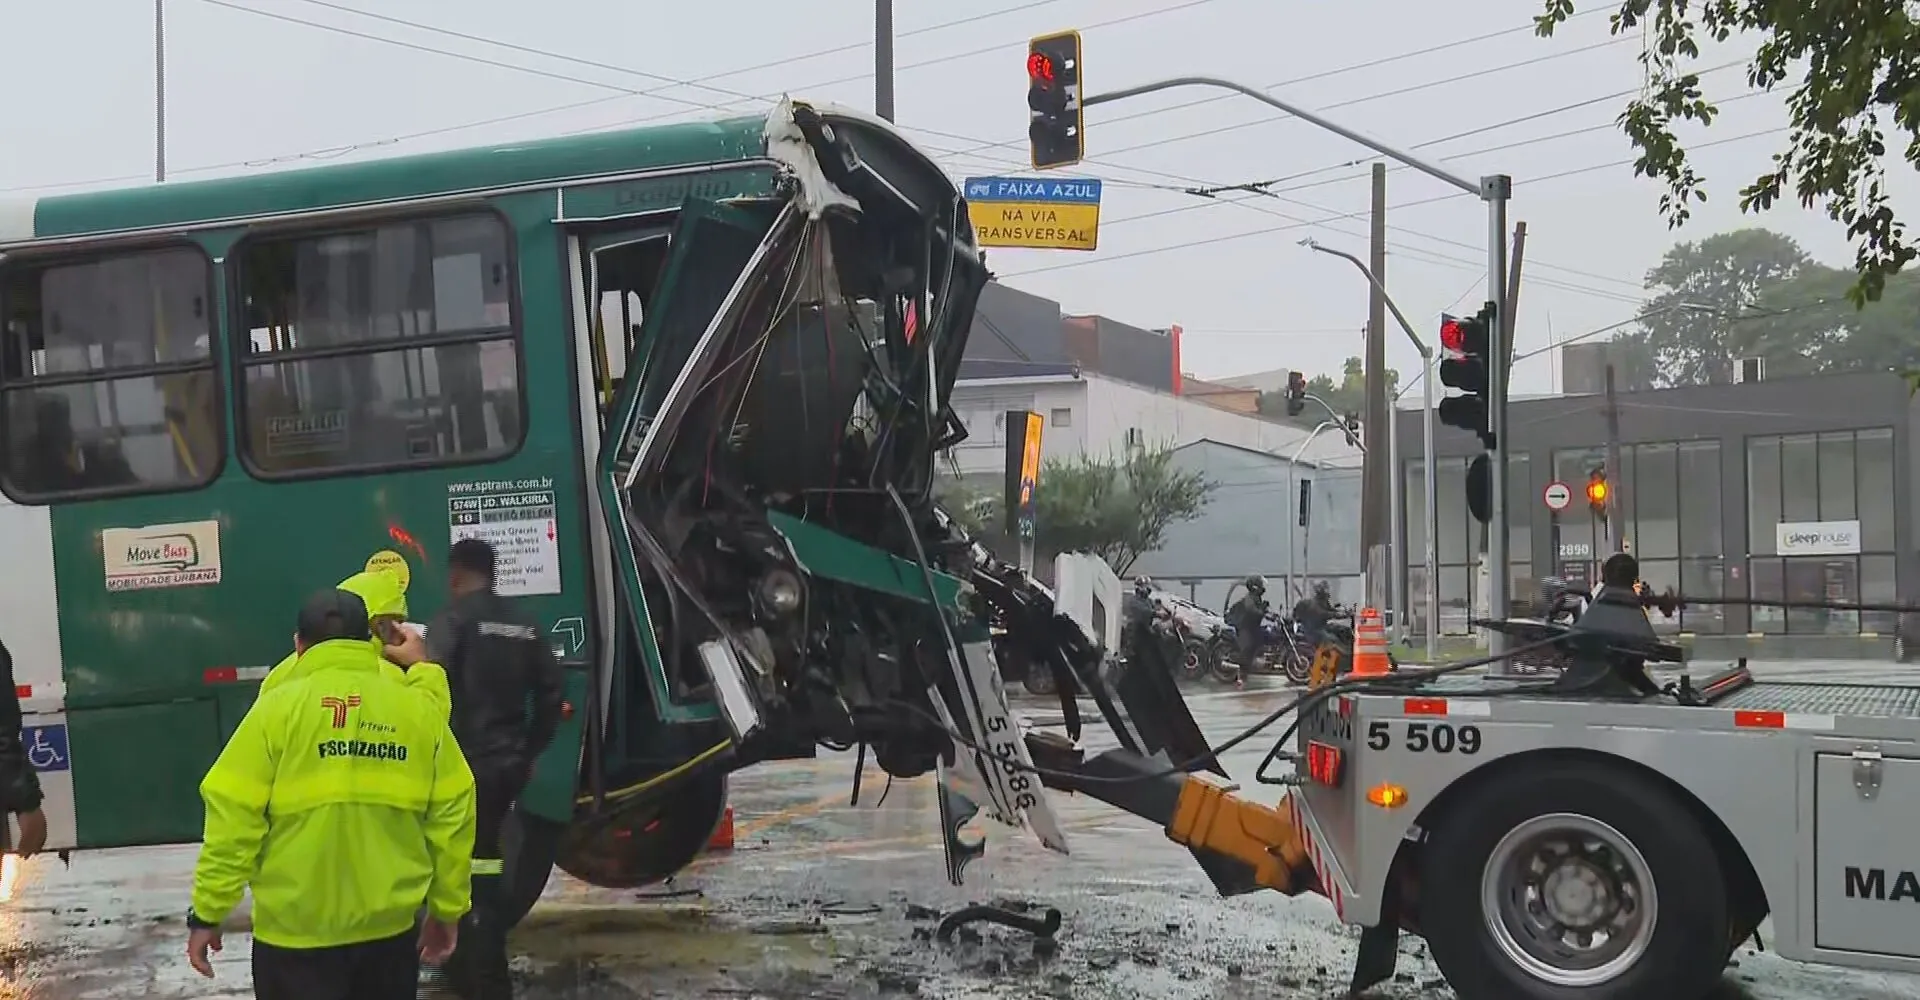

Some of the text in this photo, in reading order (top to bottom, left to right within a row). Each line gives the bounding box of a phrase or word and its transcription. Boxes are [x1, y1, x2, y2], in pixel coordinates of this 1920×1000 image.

[998, 183, 1096, 198] FAIXA AZUL
[1002, 210, 1057, 222] NA VIA
[975, 226, 1089, 242] RANSVERSAL
[448, 476, 553, 493] www.sptrans.com.br
[482, 498, 499, 508] JD.
[500, 494, 549, 507] WALKIRIA
[457, 513, 473, 524] 10
[127, 545, 161, 561] Move
[107, 571, 218, 588] MOBILIDADE URBANA
[1367, 721, 1391, 751] 5
[1405, 722, 1482, 755] 509
